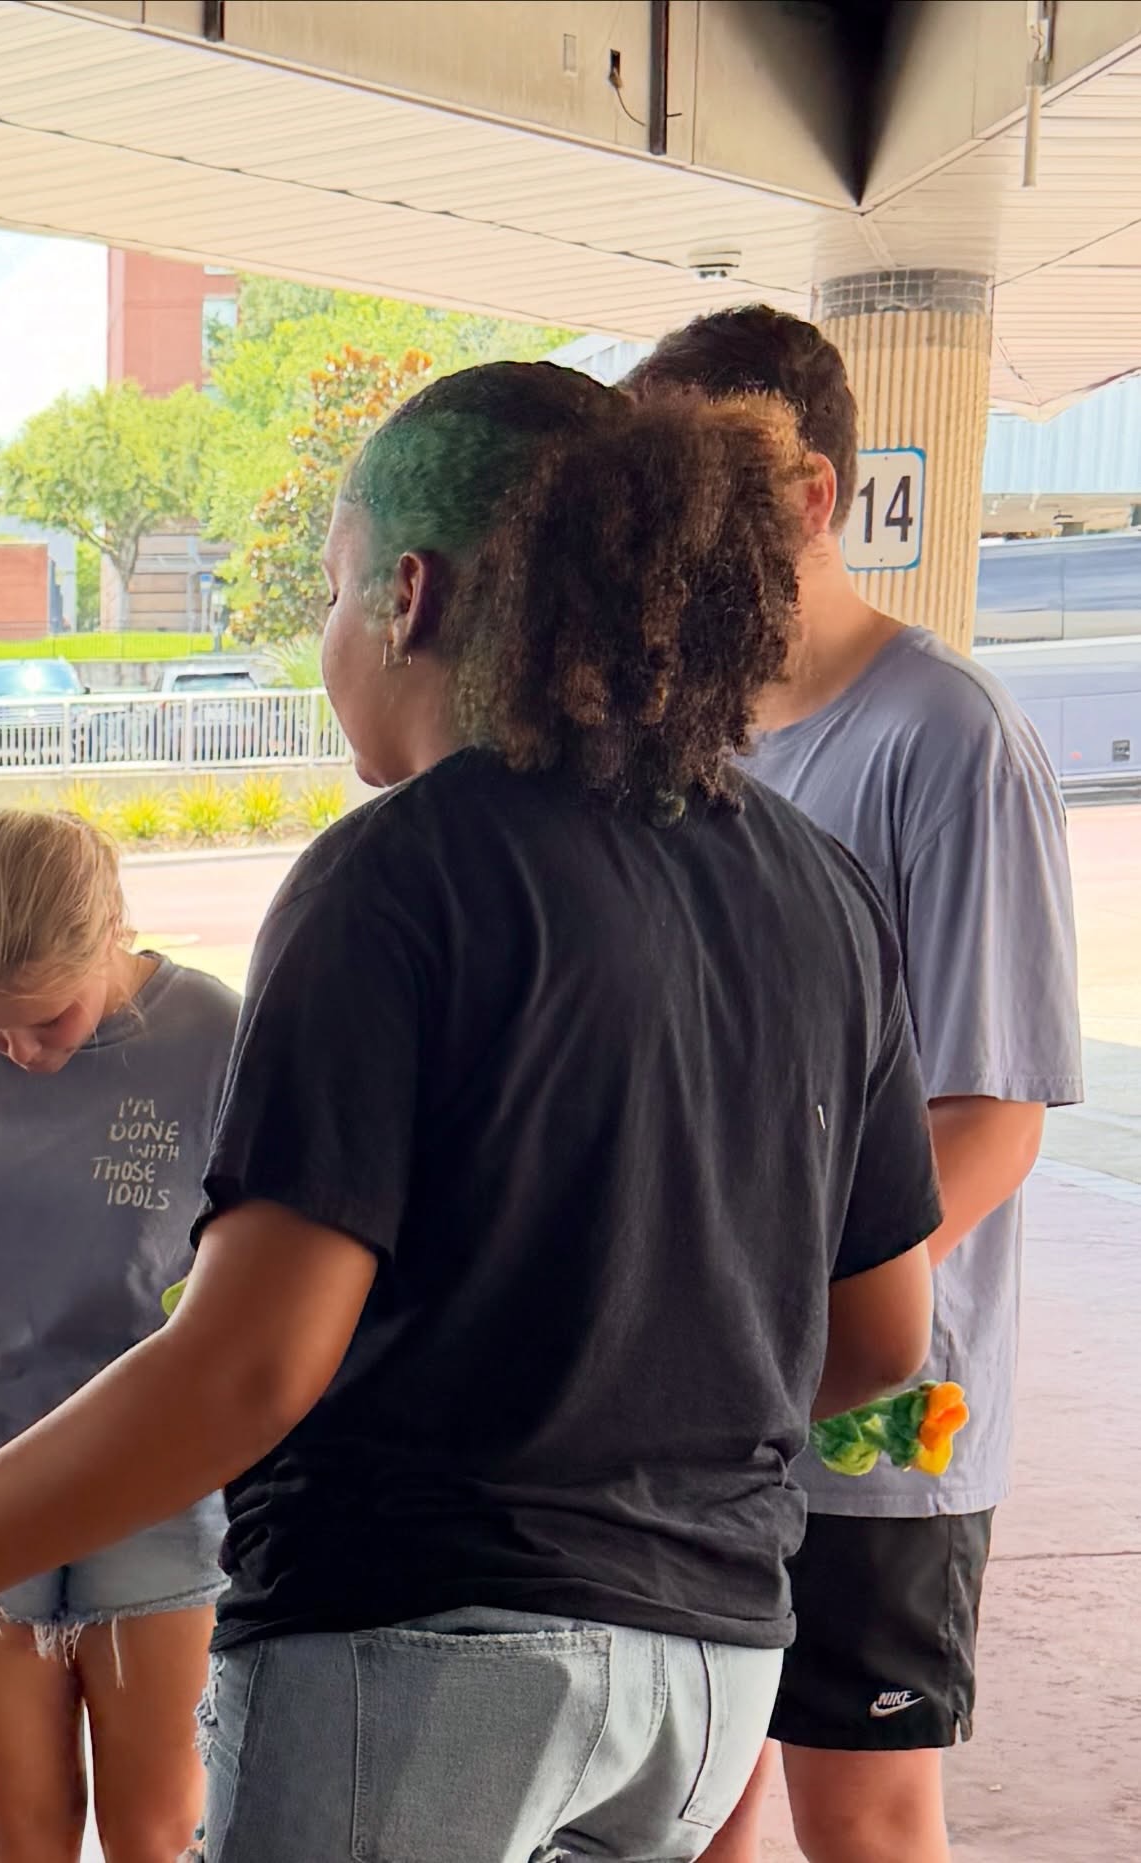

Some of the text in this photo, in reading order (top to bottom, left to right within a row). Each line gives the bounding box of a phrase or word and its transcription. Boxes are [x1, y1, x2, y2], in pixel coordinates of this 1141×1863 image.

[858, 475, 914, 544] 14
[119, 1097, 156, 1119] I'M
[109, 1120, 180, 1143] DONE
[128, 1143, 180, 1163] WITH
[90, 1155, 156, 1183] THOSE
[106, 1182, 171, 1211] IDOLS
[878, 1689, 913, 1706] NIKE
